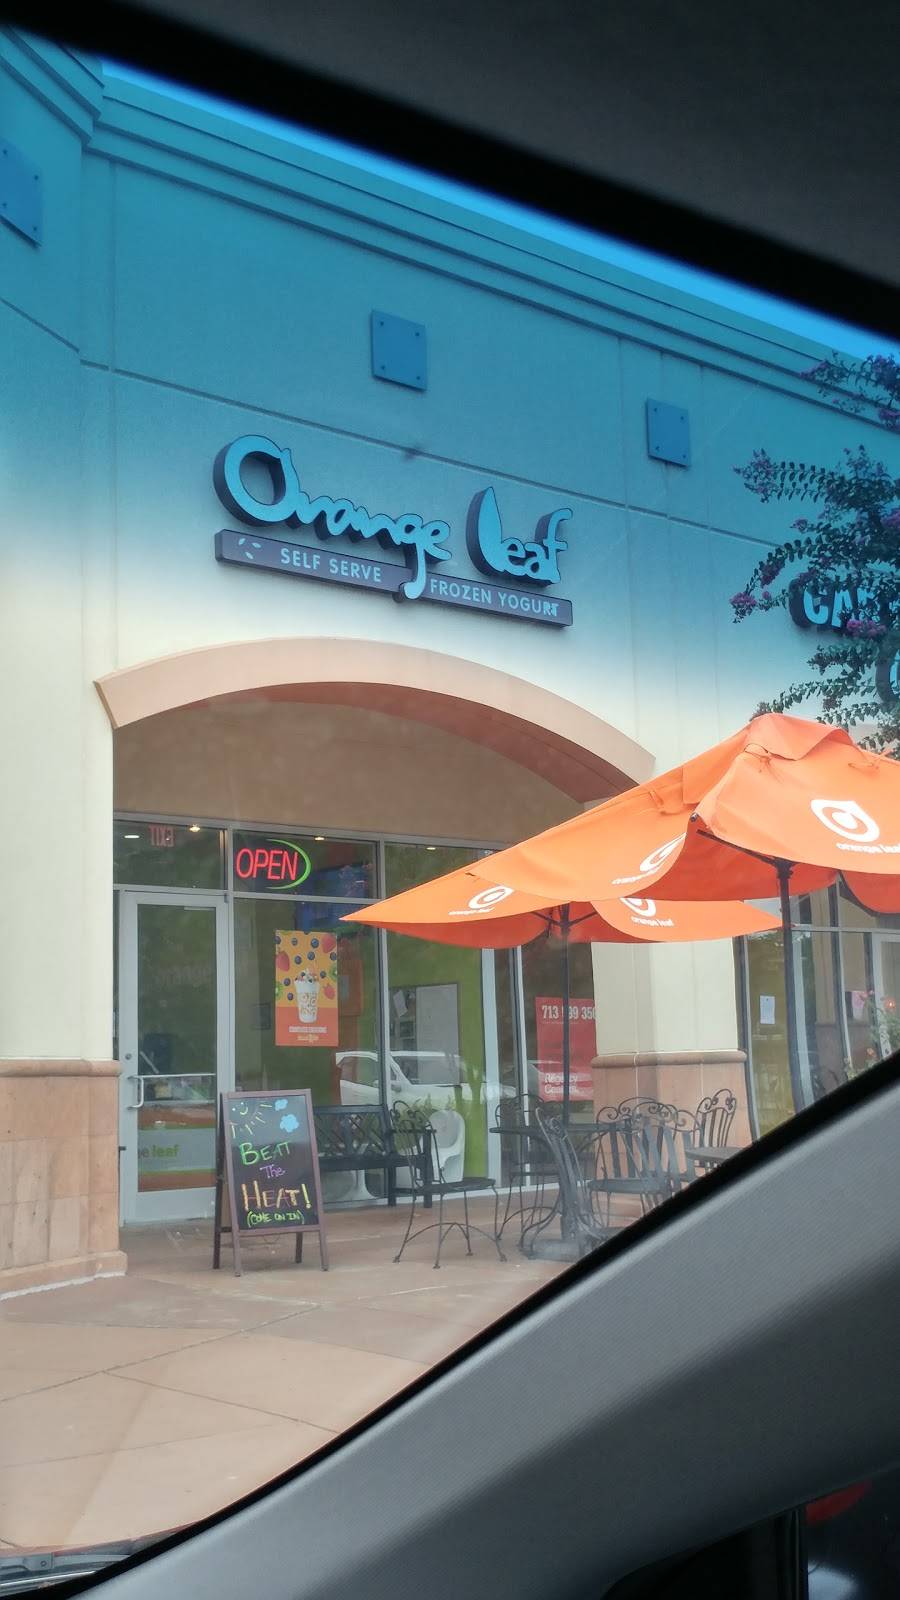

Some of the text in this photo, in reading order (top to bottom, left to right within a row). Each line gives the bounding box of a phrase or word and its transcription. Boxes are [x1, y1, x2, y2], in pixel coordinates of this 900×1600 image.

[213, 434, 452, 600] Orange
[280, 547, 382, 582] SELF SERVE
[430, 579, 560, 617] FROZEN YOGURT
[236, 848, 298, 881] OPEN
[541, 1004, 559, 1019] 713
[241, 1180, 311, 1211] HEAT!
